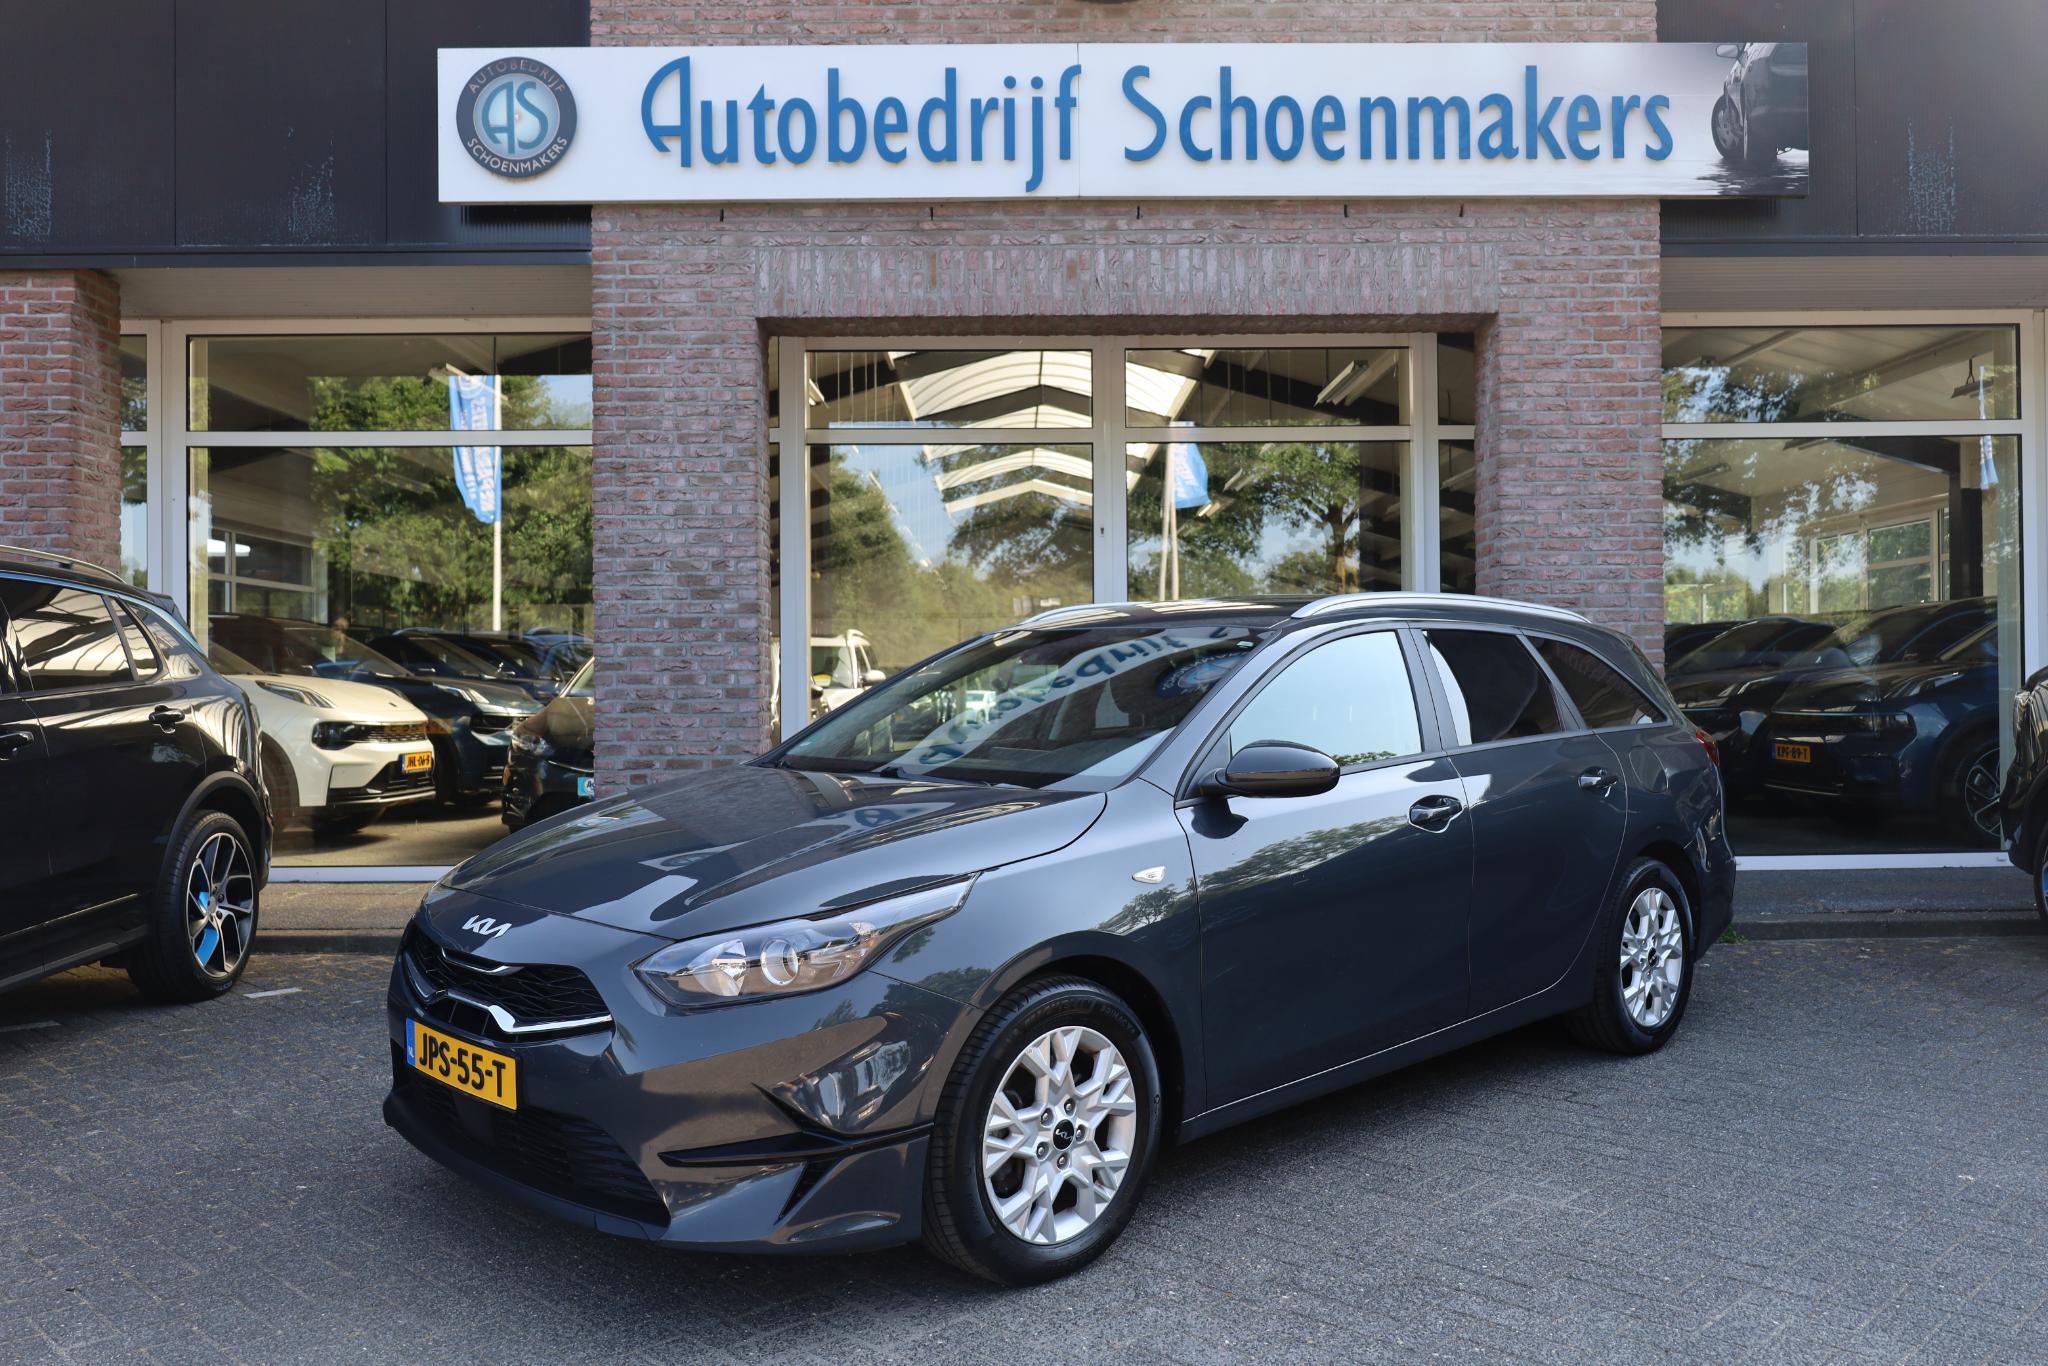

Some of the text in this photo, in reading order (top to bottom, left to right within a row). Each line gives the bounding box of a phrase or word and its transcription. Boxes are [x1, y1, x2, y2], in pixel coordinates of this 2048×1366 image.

[468, 59, 566, 94] AUTOBEDRIJF
[482, 80, 549, 155] AS
[641, 55, 1674, 193] Autobedrijf Schoenmakers
[467, 136, 568, 174] SCHOENMAKERS
[419, 1033, 507, 1098] JPS-55-T
